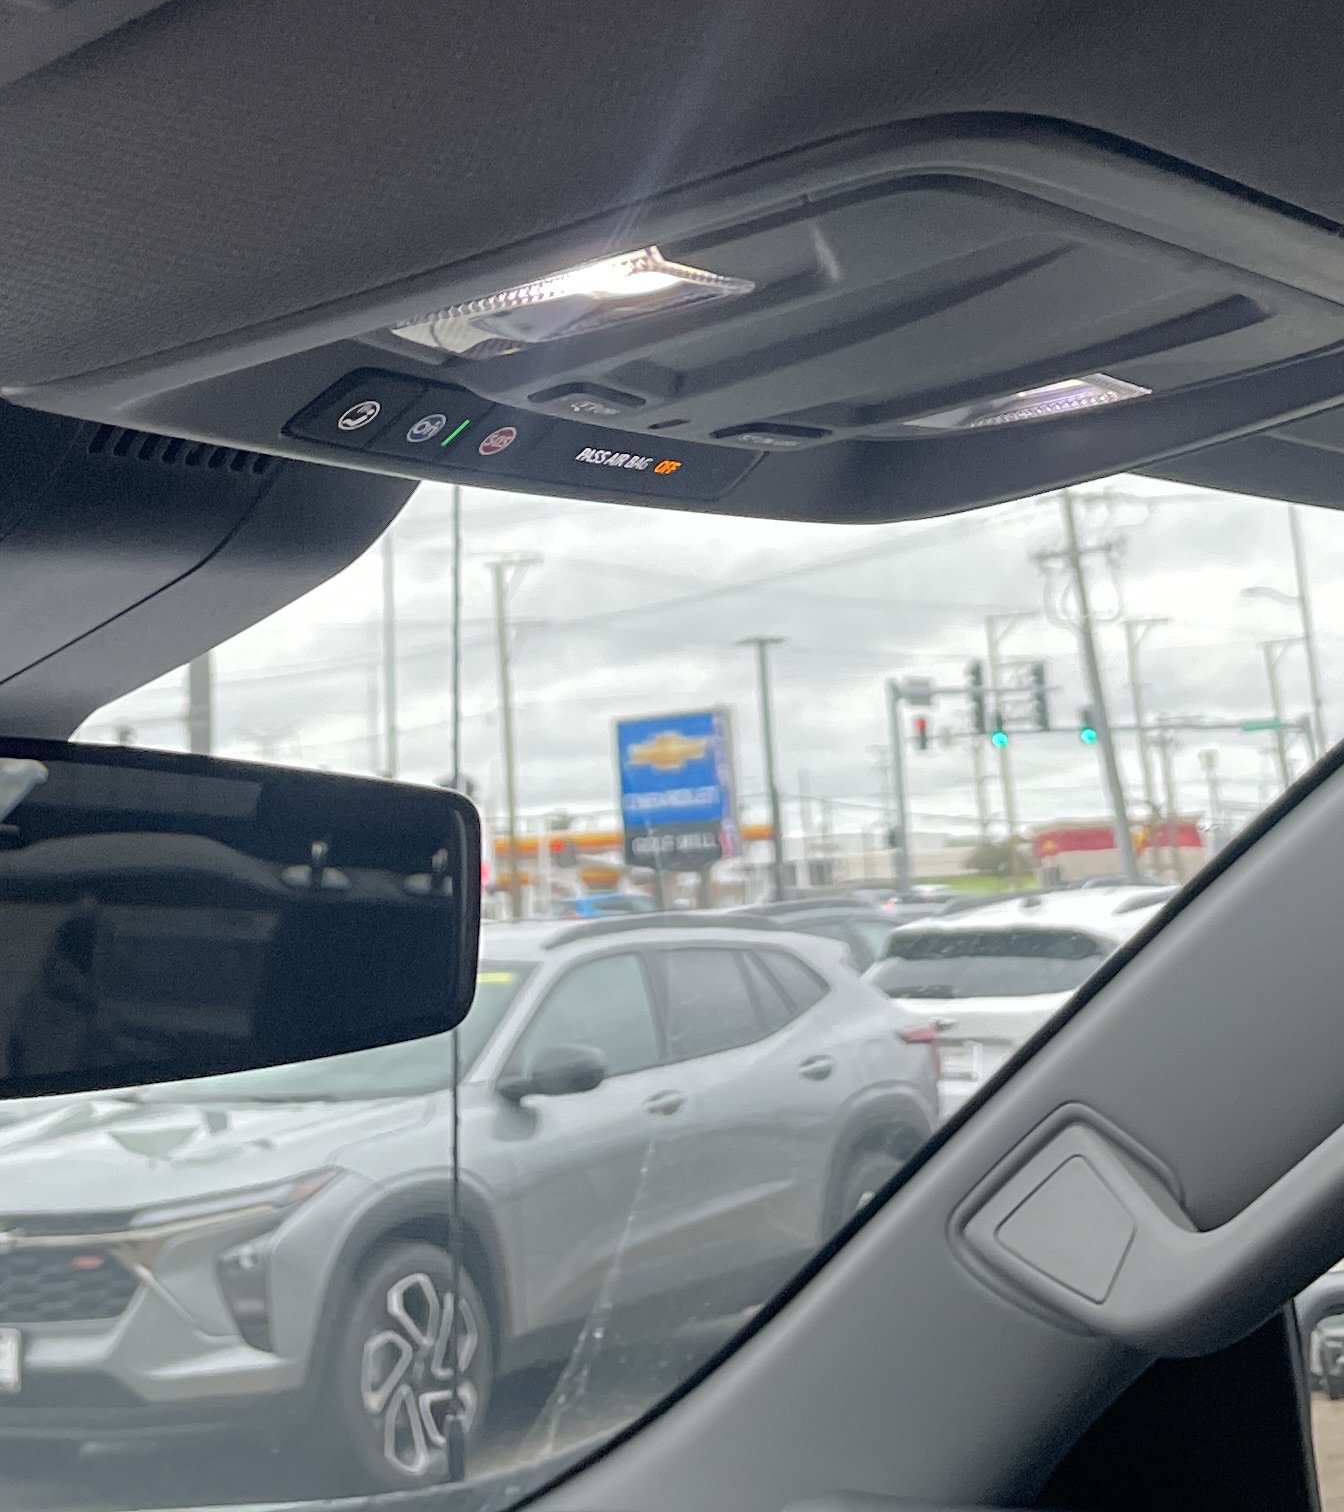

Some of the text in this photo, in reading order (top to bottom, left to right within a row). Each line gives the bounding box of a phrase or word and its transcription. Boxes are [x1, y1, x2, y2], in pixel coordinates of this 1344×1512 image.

[576, 448, 682, 474] PASS AIR BAG OFF
